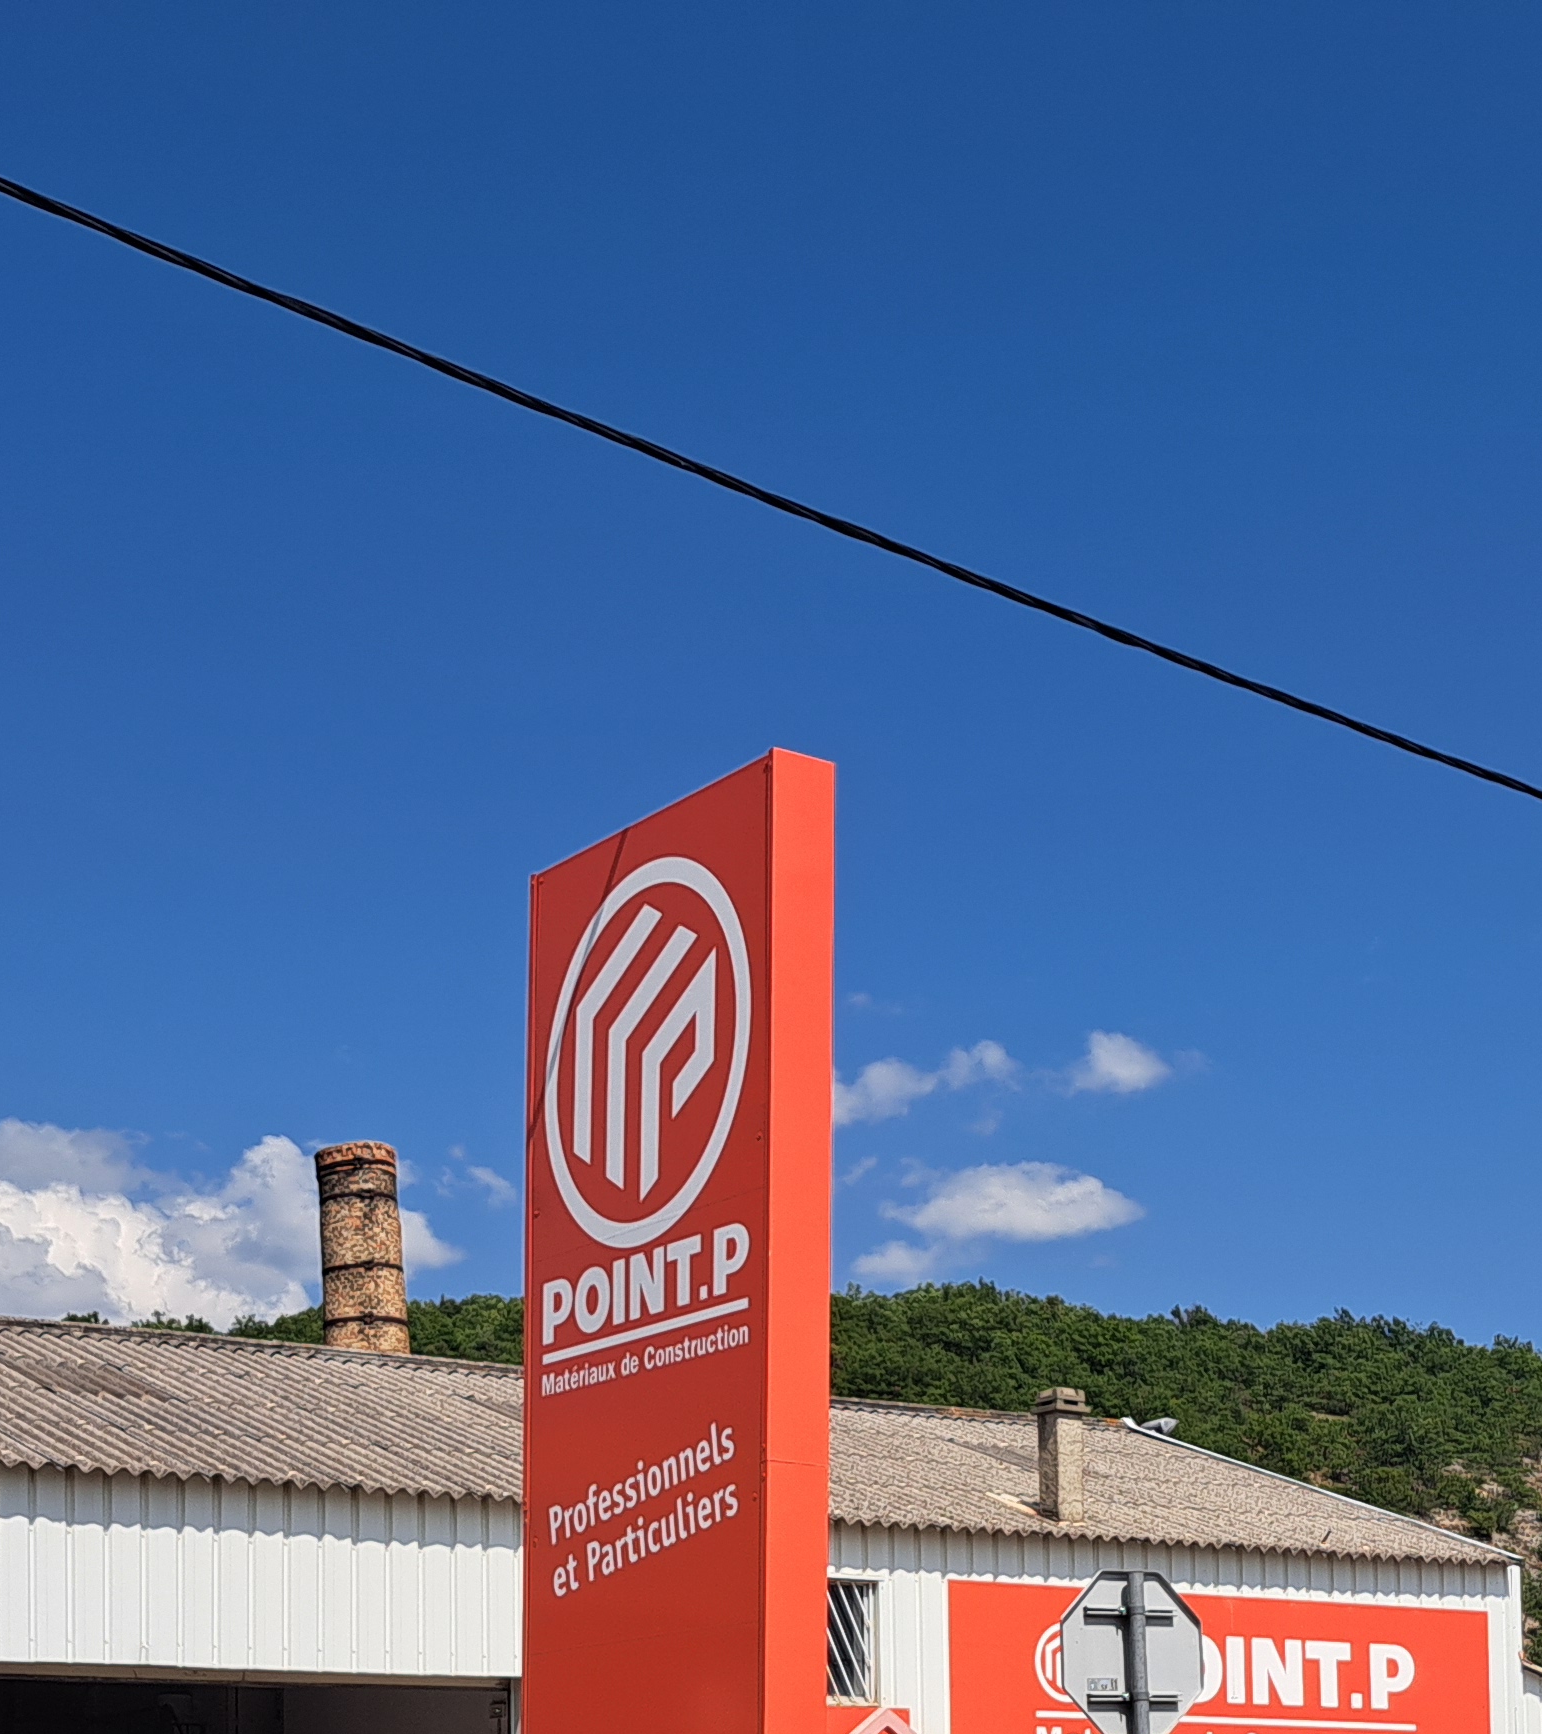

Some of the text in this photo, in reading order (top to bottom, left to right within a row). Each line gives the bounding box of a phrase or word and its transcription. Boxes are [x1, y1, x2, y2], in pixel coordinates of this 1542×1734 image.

[542, 1222, 750, 1346] POINT.P
[542, 1324, 749, 1397] Matériaux de Construction
[548, 1421, 735, 1546] Professionnels
[553, 1484, 739, 1597] et Particuliers
[1193, 1634, 1416, 1710] INT.P
